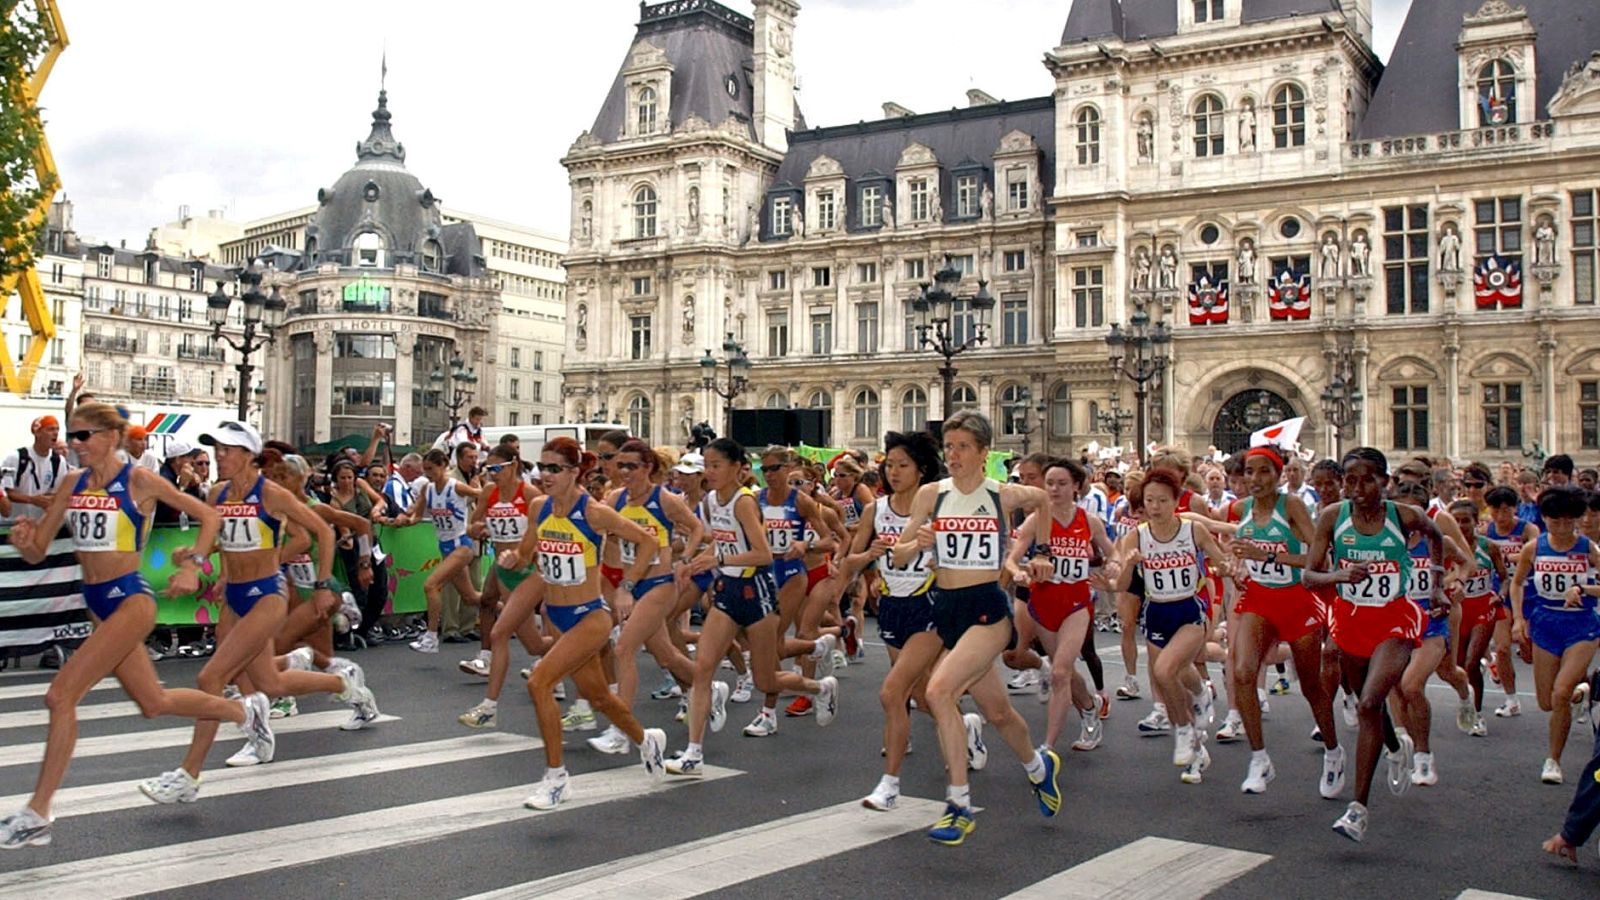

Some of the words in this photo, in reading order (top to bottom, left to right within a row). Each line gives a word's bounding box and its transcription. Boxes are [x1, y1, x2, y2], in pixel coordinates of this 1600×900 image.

[940, 519, 998, 531] TOYOTA
[946, 533, 991, 560] 975
[1052, 537, 1087, 547] USSIA
[1050, 547, 1089, 557] OYOTA
[1347, 549, 1386, 561] ETHIOPIA
[1144, 556, 1196, 570] TOYOTA
[1341, 559, 1397, 572] TOOTA
[1538, 562, 1585, 572] TOYOTA
[1153, 567, 1191, 591] 616
